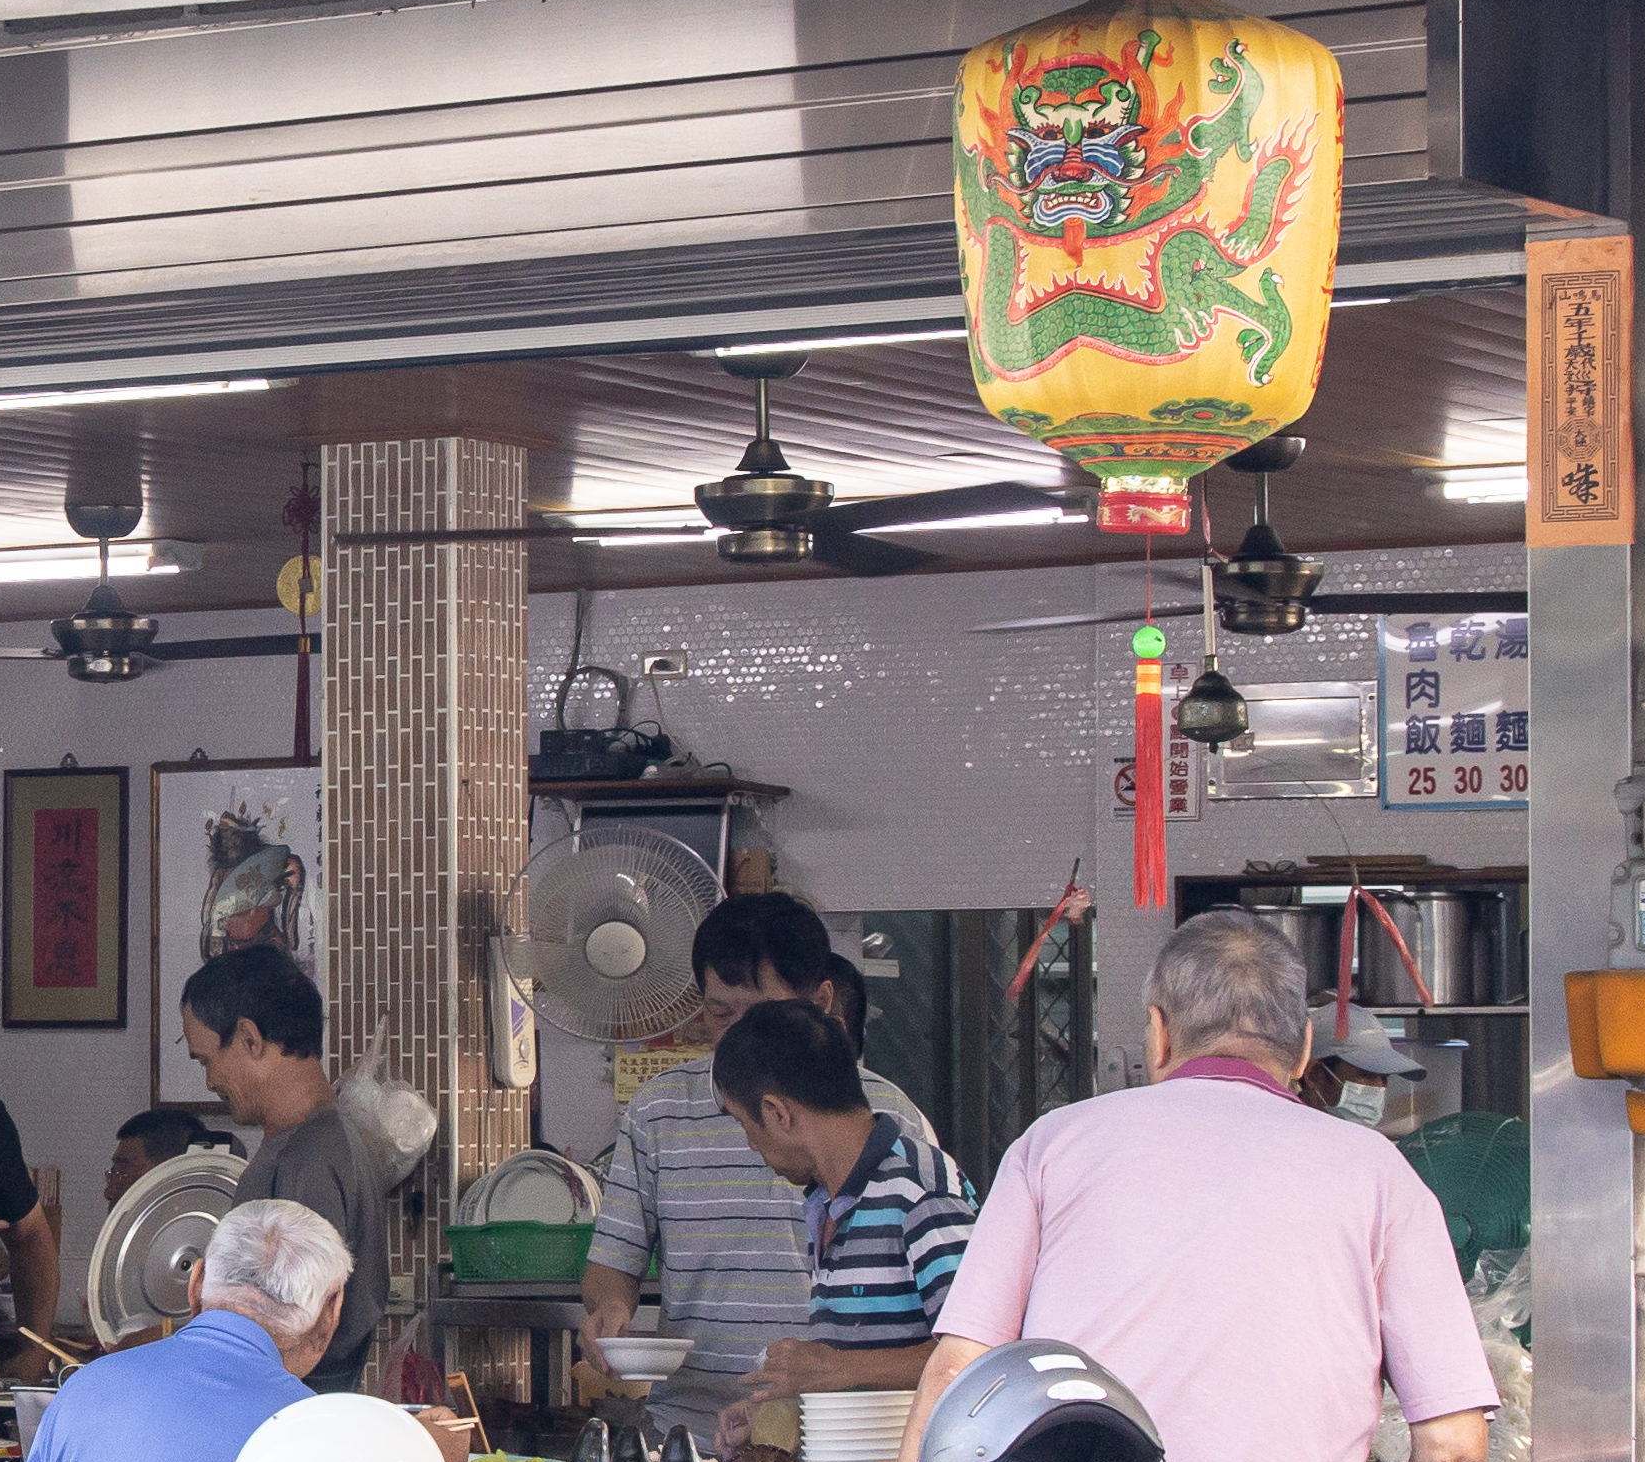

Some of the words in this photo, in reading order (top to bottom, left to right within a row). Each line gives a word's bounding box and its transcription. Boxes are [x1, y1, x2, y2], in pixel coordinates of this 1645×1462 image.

[1408, 766, 1437, 796] 25
[1453, 765, 1483, 794] 30
[1499, 763, 1529, 793] 30
